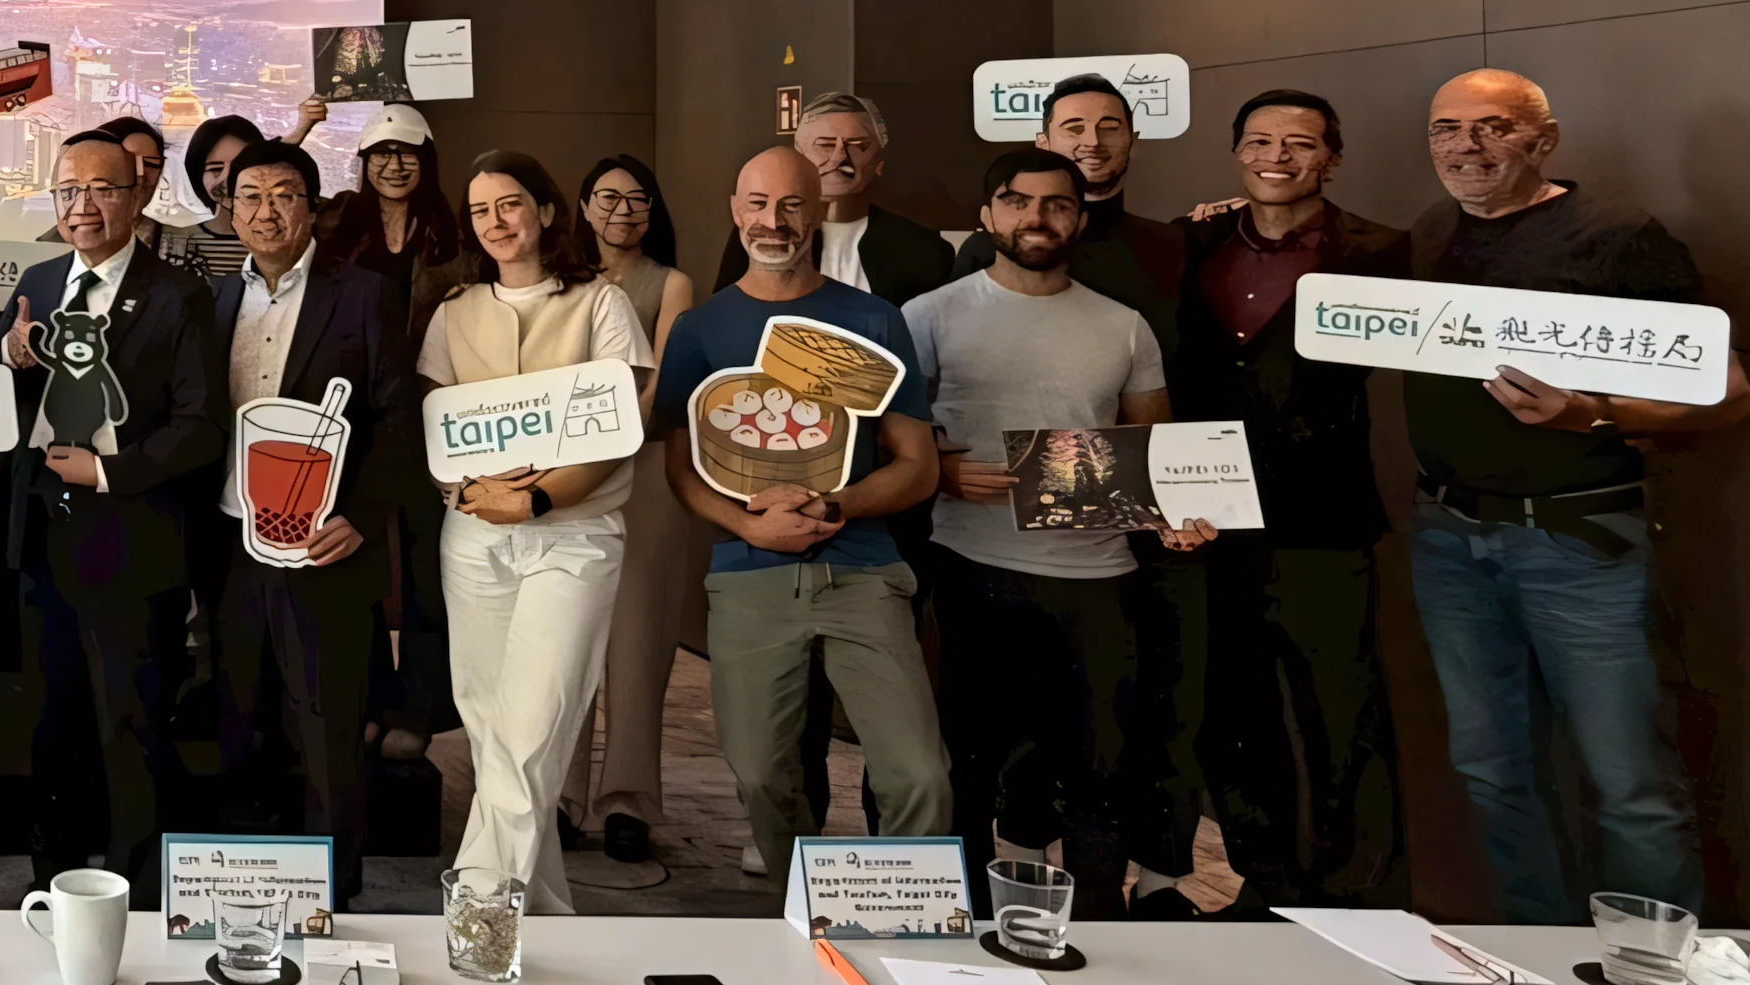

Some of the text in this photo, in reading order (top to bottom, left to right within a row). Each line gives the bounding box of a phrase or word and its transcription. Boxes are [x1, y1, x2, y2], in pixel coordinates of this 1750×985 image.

[990, 83, 1043, 113] tai
[1316, 301, 1418, 340] taipei
[440, 411, 554, 452] taipei
